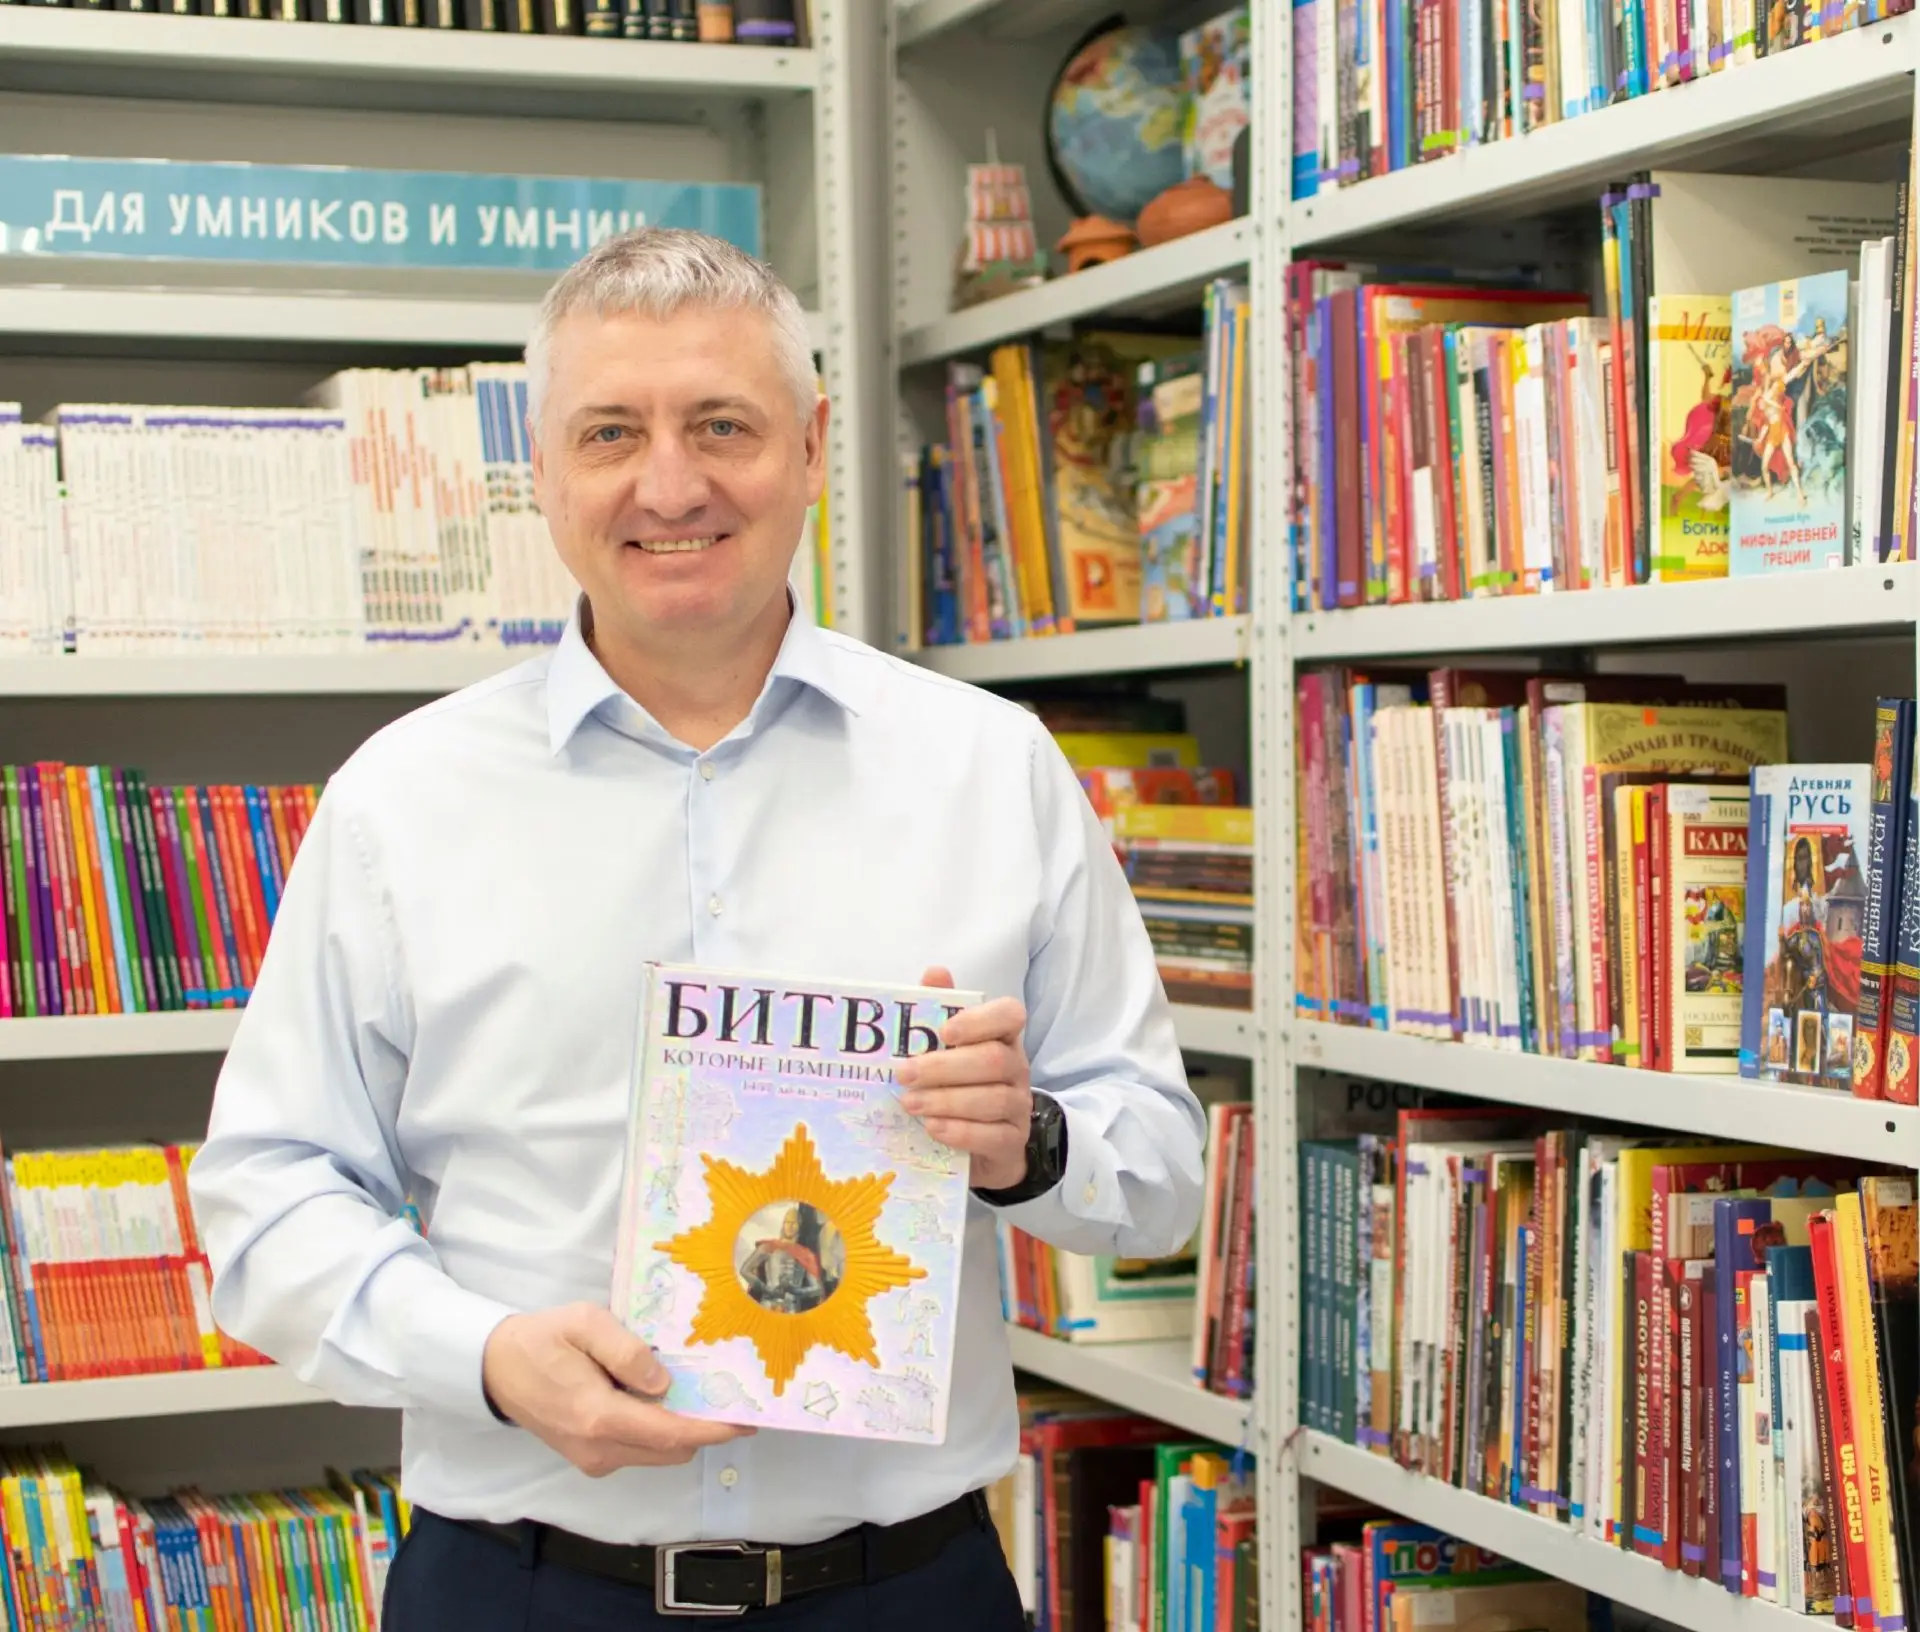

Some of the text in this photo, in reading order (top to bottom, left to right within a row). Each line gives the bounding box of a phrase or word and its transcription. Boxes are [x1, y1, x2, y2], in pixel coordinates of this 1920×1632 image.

[44, 188, 146, 243] ДЛЯ
[169, 193, 410, 245] УМНИКОВ
[430, 203, 456, 246] И
[1683, 518, 1719, 535] Боги
[1740, 522, 1838, 549] МИФЫ ДРЕВНЕЙ
[1763, 549, 1812, 568] ГРЕЦИИ
[1599, 734, 1669, 766] БЫЧАИ
[1788, 777, 1852, 791] Древняя
[1788, 792, 1852, 820] РУСЬ
[1689, 831, 1748, 851] КАРА
[1872, 813, 1887, 863] РУСИ
[1585, 793, 1603, 984] БЫТ РУССКОГО НАРОДА
[1865, 868, 1883, 957] ДРЕВНЕЙ
[663, 1049, 770, 1074] КОТОРЫЕ
[1636, 1299, 1648, 1366] СЛОВО
[1651, 1257, 1662, 1368] ГРОЗНУЮ
[1680, 1317, 1691, 1387] казачество
[1636, 1371, 1649, 1458] РОДНОЕ
[1681, 1388, 1692, 1472] Астраханское
[1722, 1370, 1733, 1432] КАЗАКИ
[1529, 1384, 1539, 1504] ОГАТЫРИ
[1817, 1392, 1832, 1482] Нижегородское
[1868, 1464, 1881, 1506] 1917
